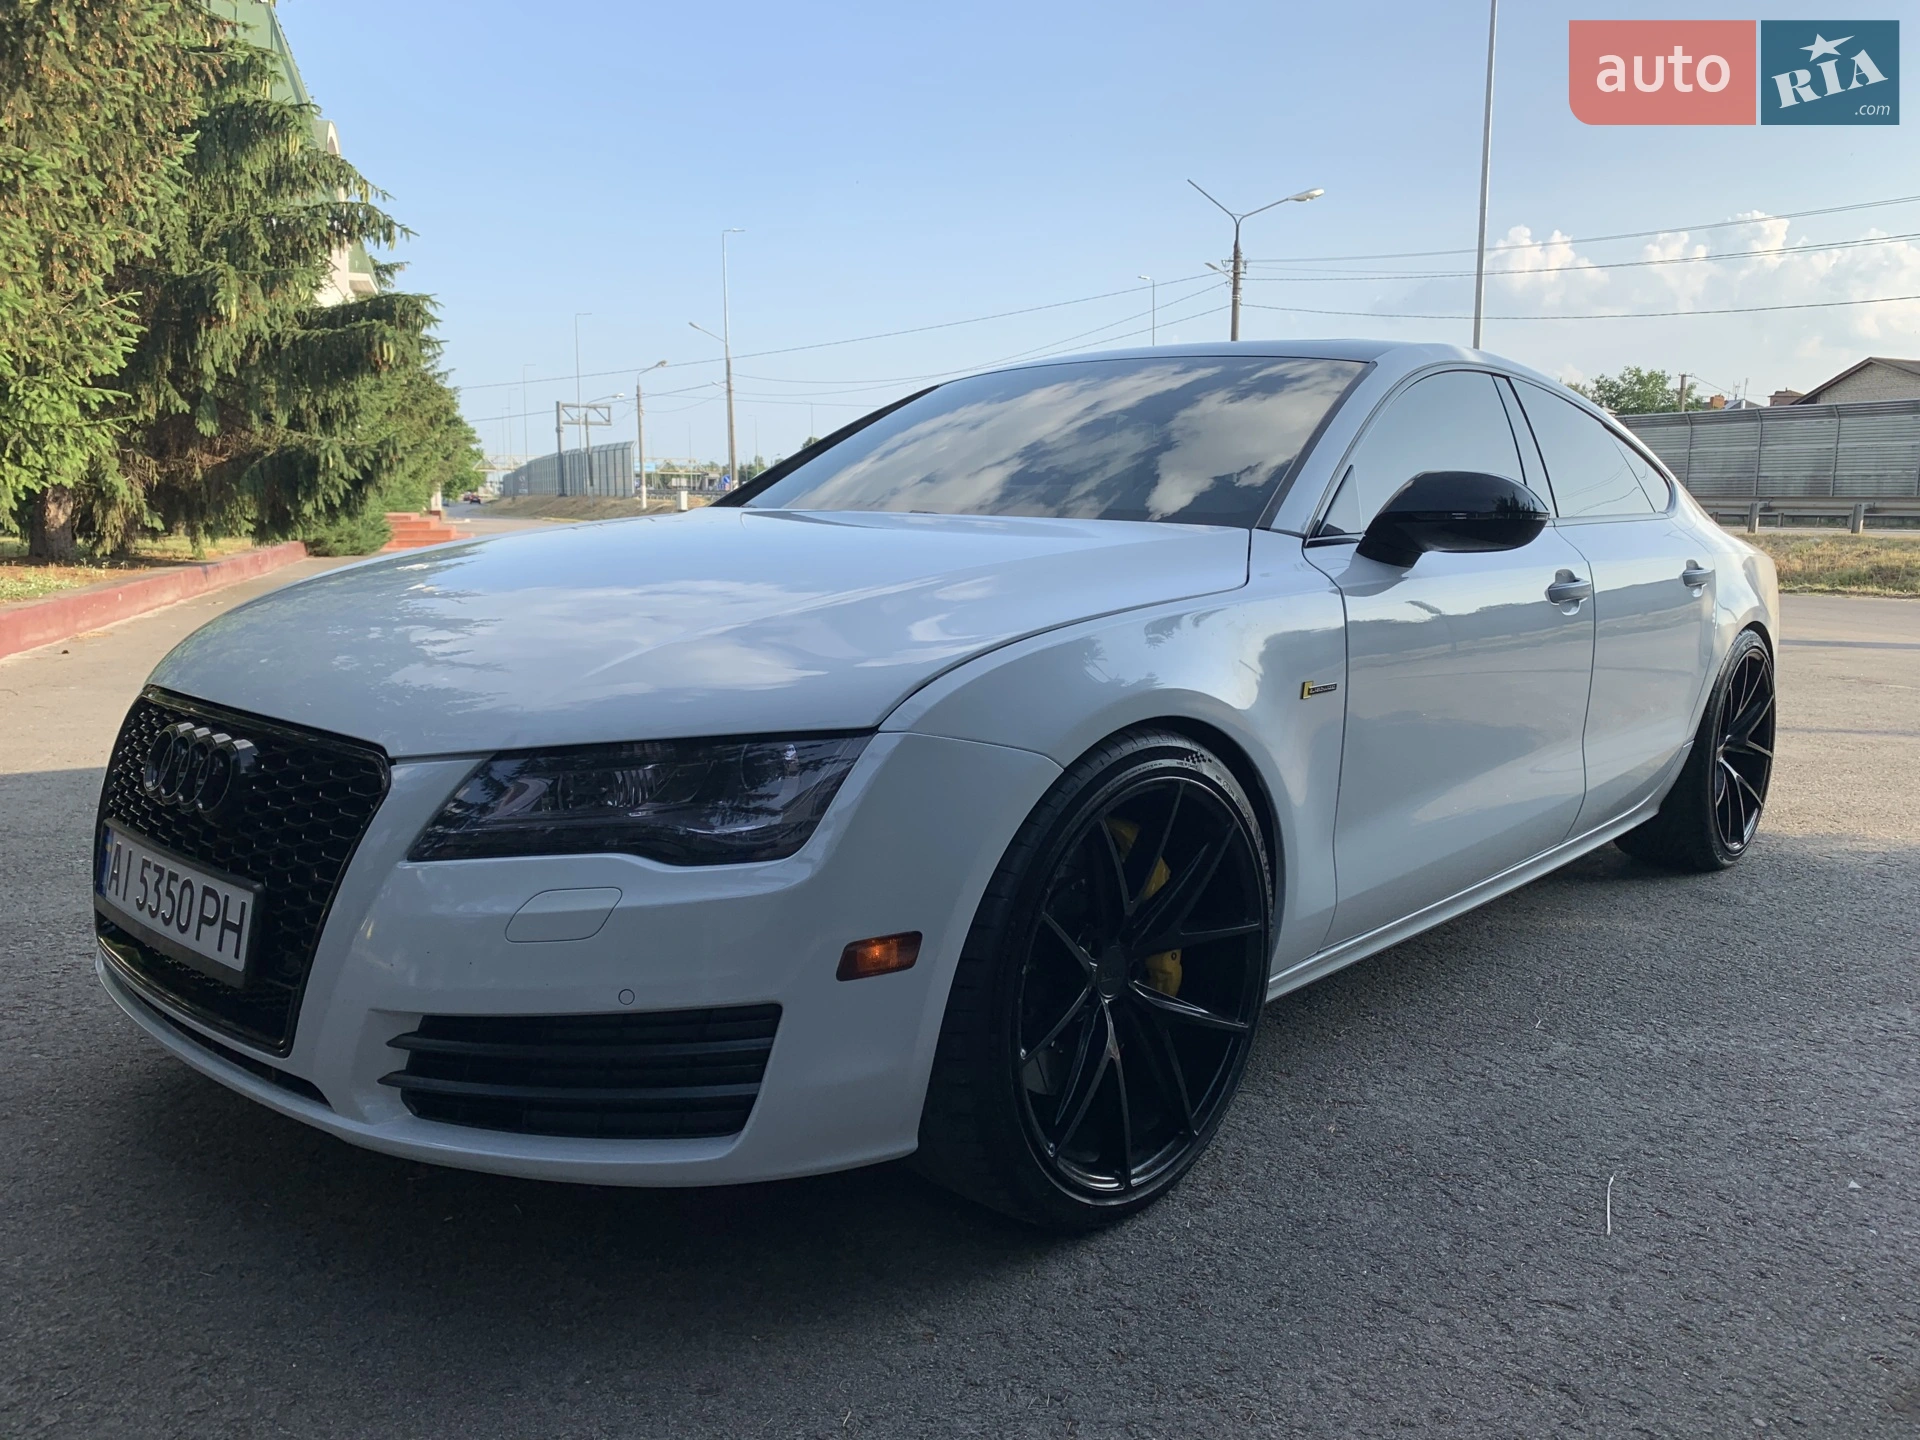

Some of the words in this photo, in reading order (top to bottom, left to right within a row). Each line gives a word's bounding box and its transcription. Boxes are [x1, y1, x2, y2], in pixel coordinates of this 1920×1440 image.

[107, 841, 133, 902] AI
[136, 856, 194, 934] 5350
[195, 884, 247, 960] PH
